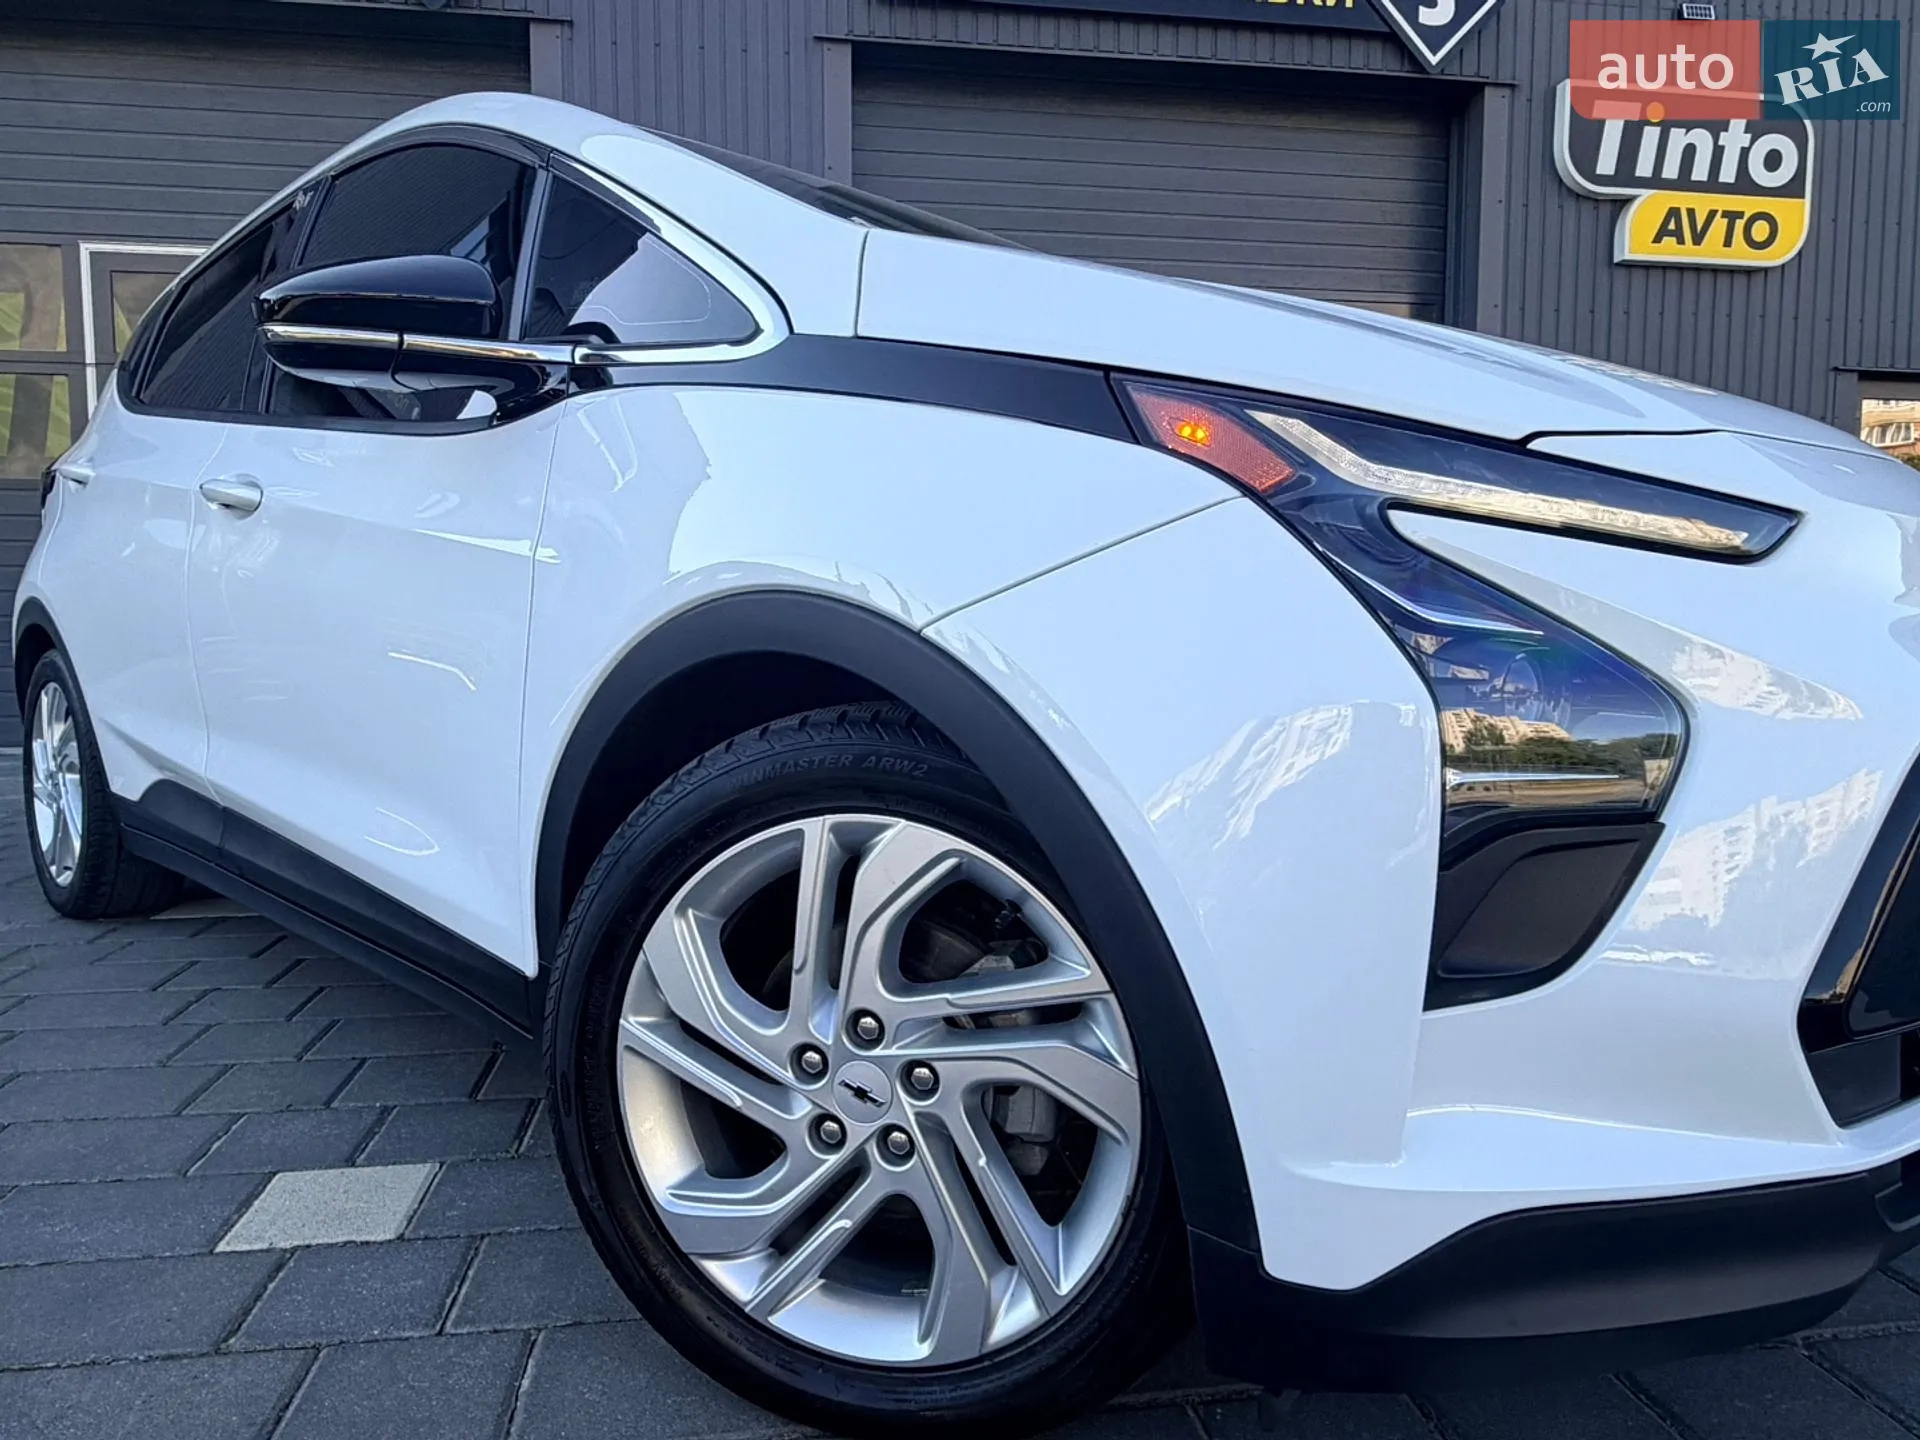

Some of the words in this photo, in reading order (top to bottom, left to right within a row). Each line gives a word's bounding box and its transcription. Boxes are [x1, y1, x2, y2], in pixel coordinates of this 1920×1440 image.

[1592, 100, 1799, 188] Tinto
[1651, 206, 1779, 250] AVTO
[862, 755, 929, 777] ARW2
